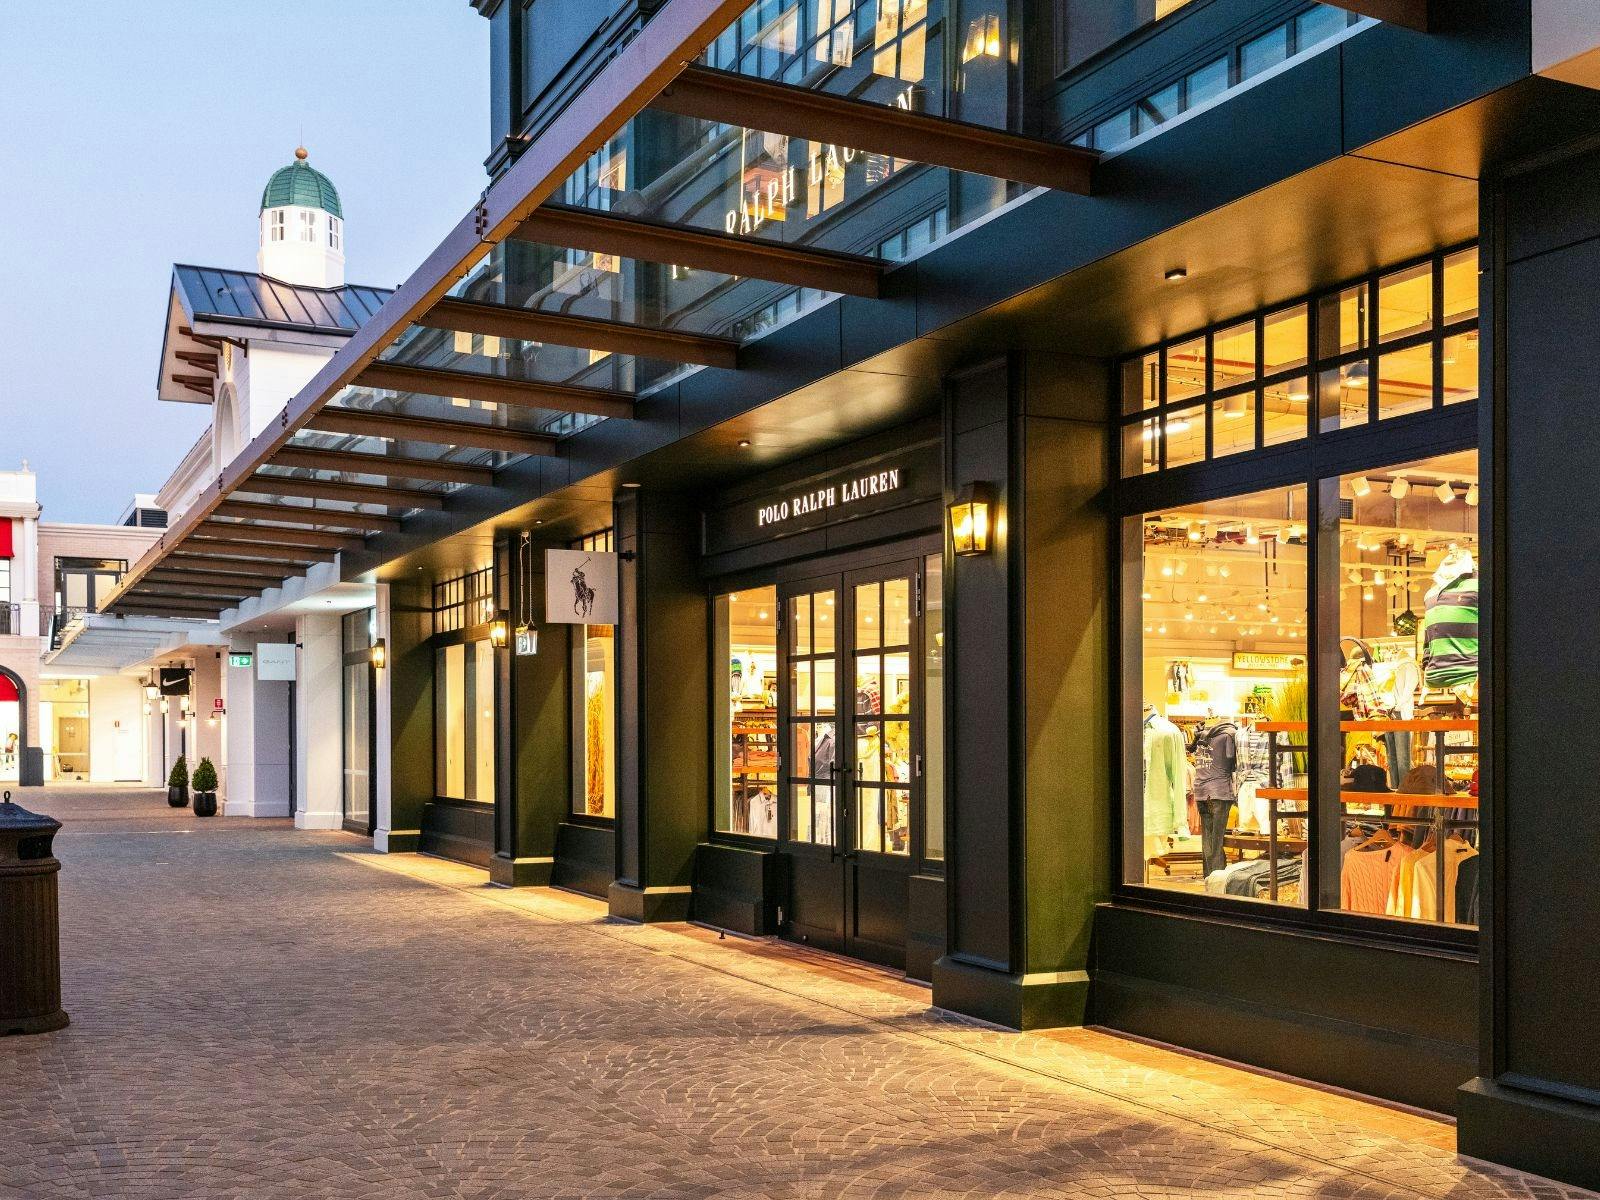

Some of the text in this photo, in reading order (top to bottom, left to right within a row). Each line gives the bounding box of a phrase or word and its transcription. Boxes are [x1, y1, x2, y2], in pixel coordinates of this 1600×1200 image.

[725, 85, 912, 235] RALPH LAUN
[758, 469, 899, 526] POLO RALPH LAUREN
[1237, 655, 1289, 664] YELLOWSTONE
